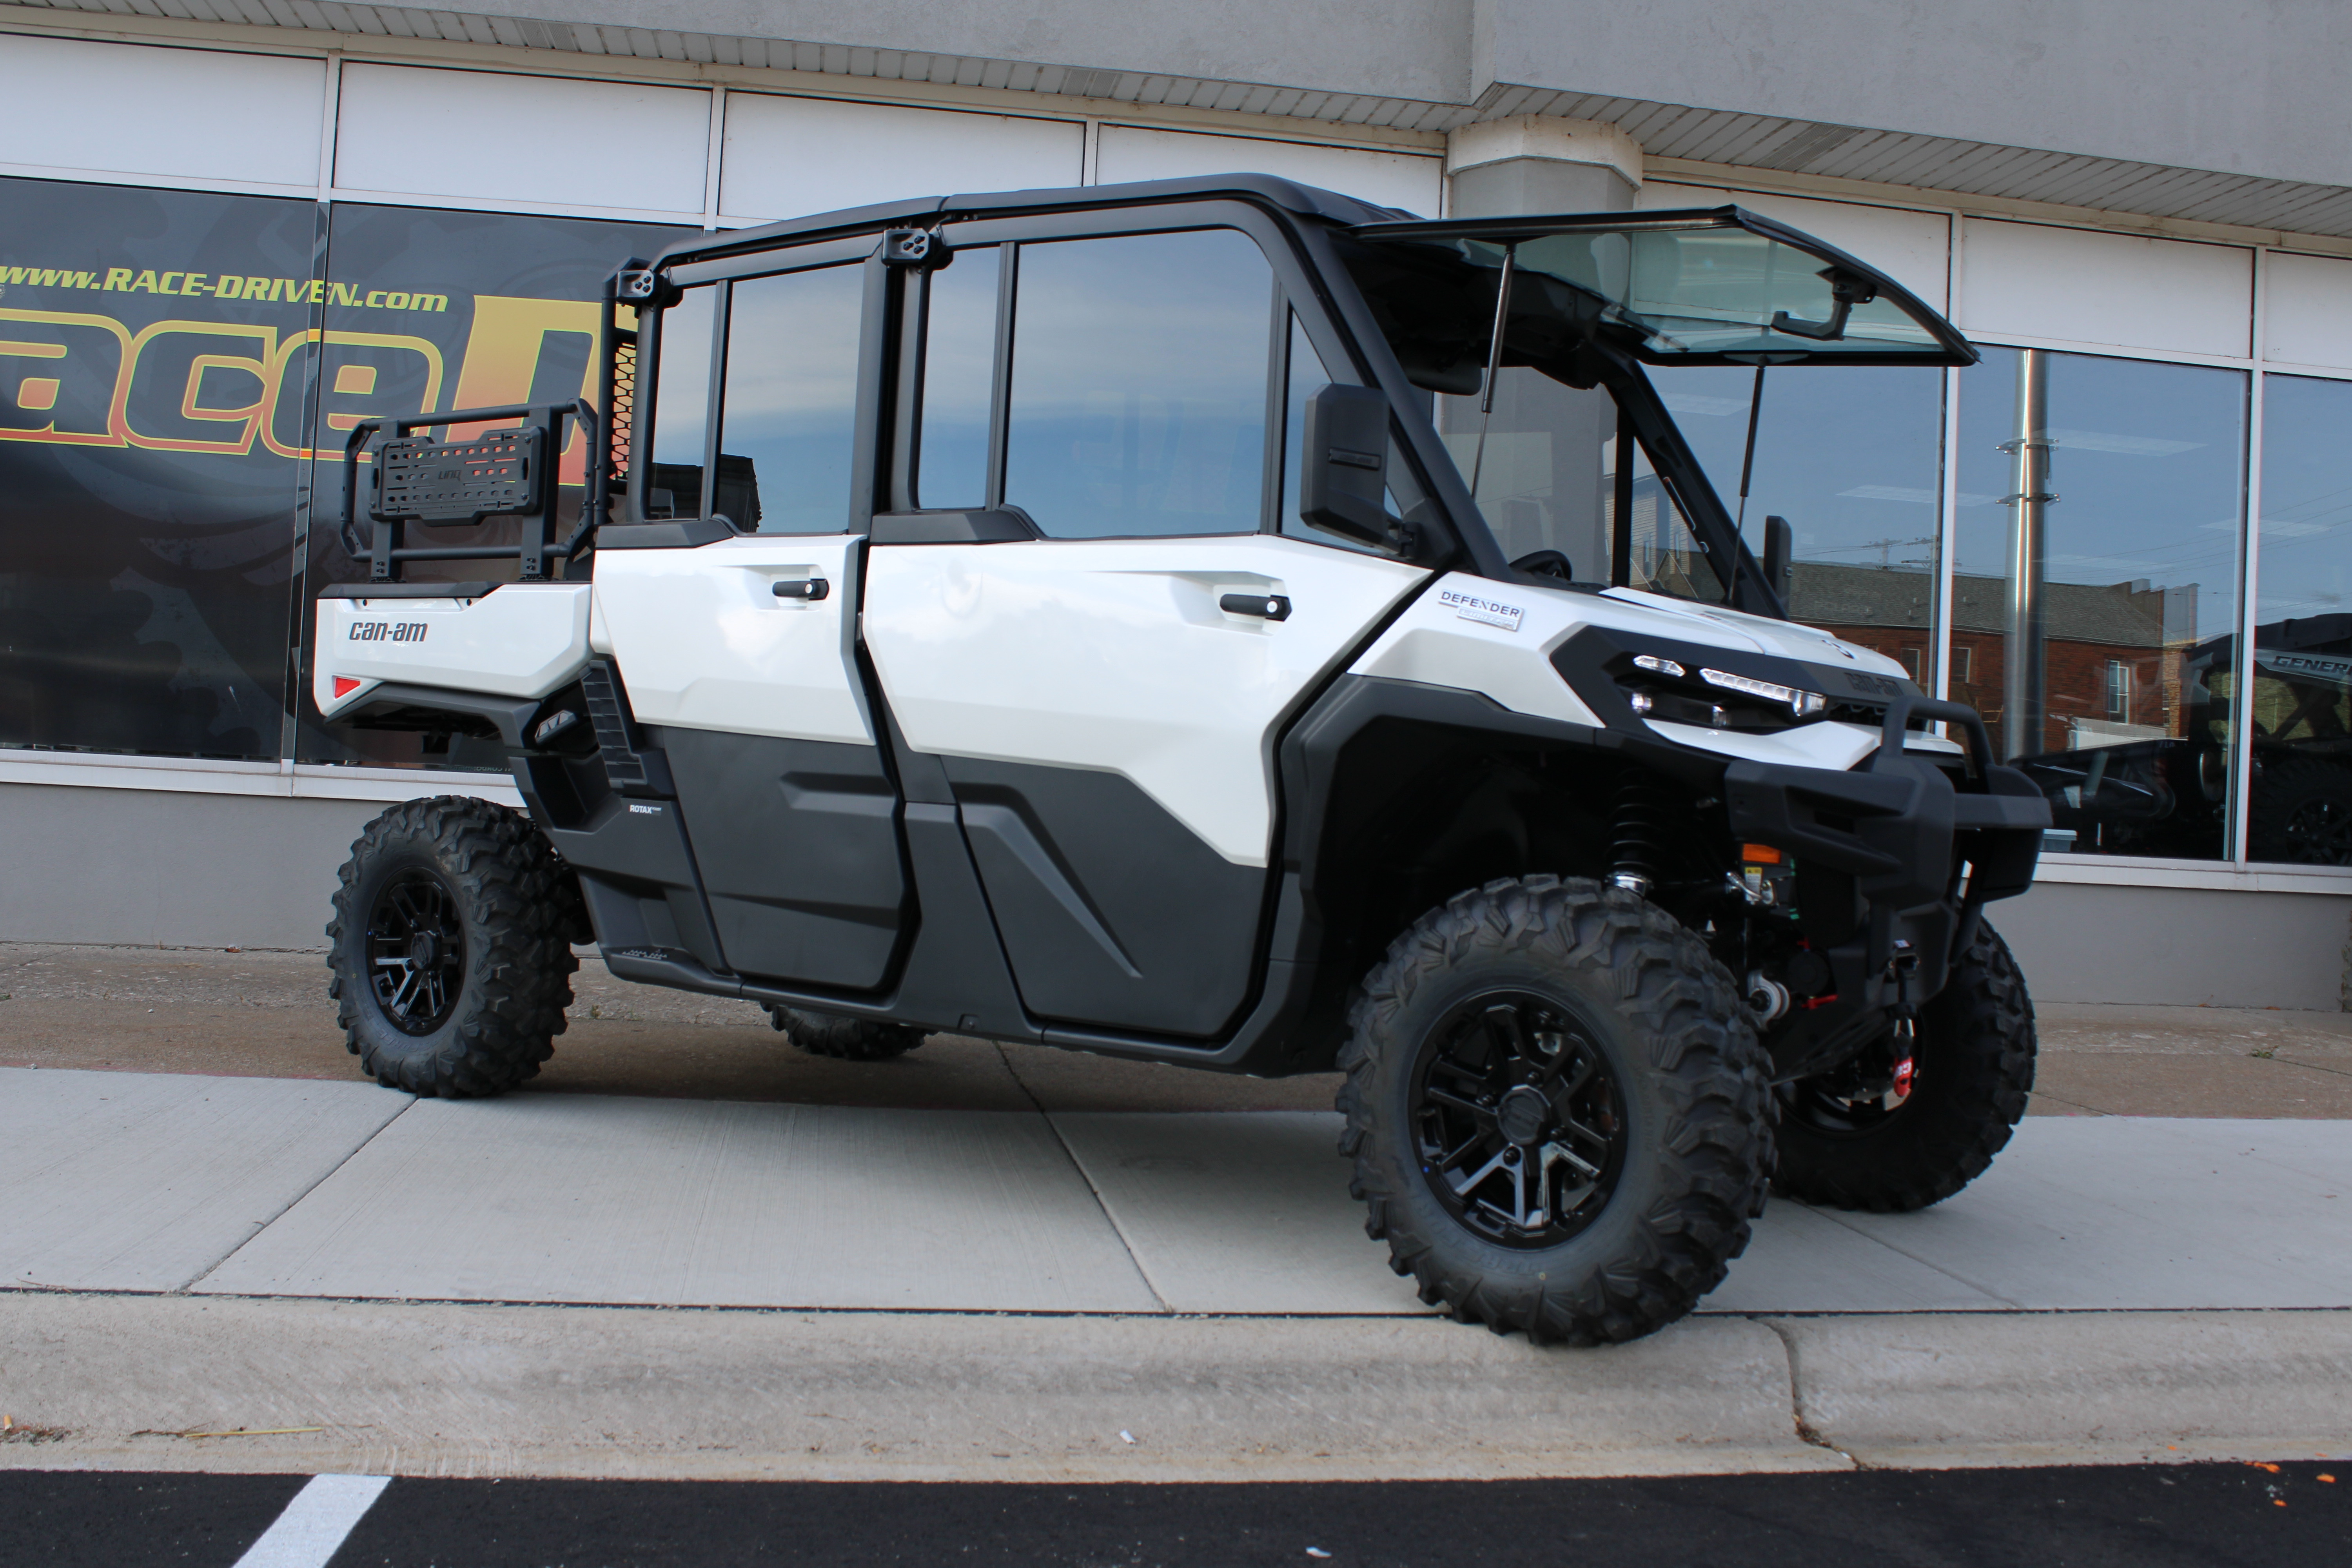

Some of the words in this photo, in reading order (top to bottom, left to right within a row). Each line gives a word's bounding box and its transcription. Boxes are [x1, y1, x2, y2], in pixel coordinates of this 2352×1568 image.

[0, 265, 448, 312] www.RACE-DRIVEN.com
[1441, 591, 1521, 617] DEFENDER
[2272, 655, 2352, 675] GENER
[630, 804, 652, 814] ROTAX
